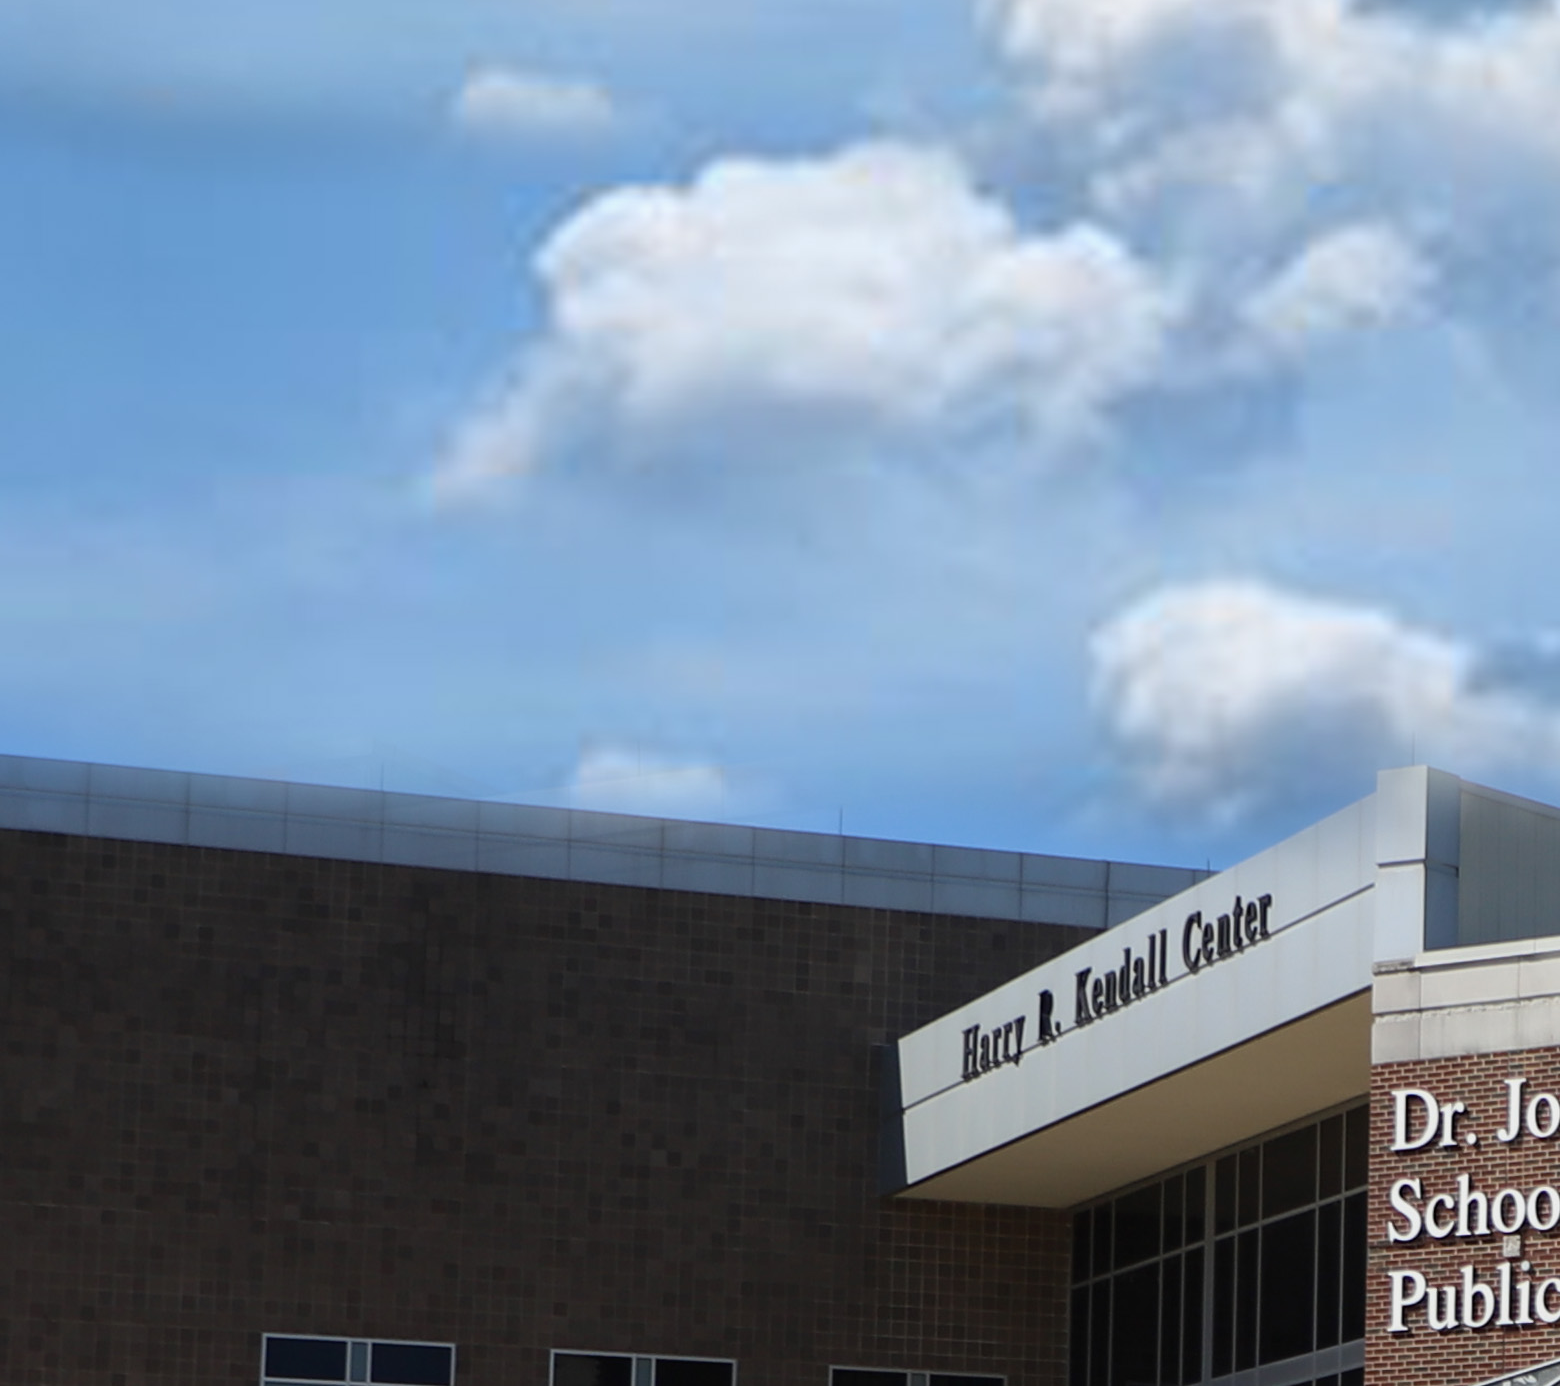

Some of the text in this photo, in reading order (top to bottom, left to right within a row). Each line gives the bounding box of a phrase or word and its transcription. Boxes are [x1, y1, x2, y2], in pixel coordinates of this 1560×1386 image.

[960, 892, 1273, 1084] Harry R. Kendall Center
[1390, 1087, 1478, 1152] Dr.
